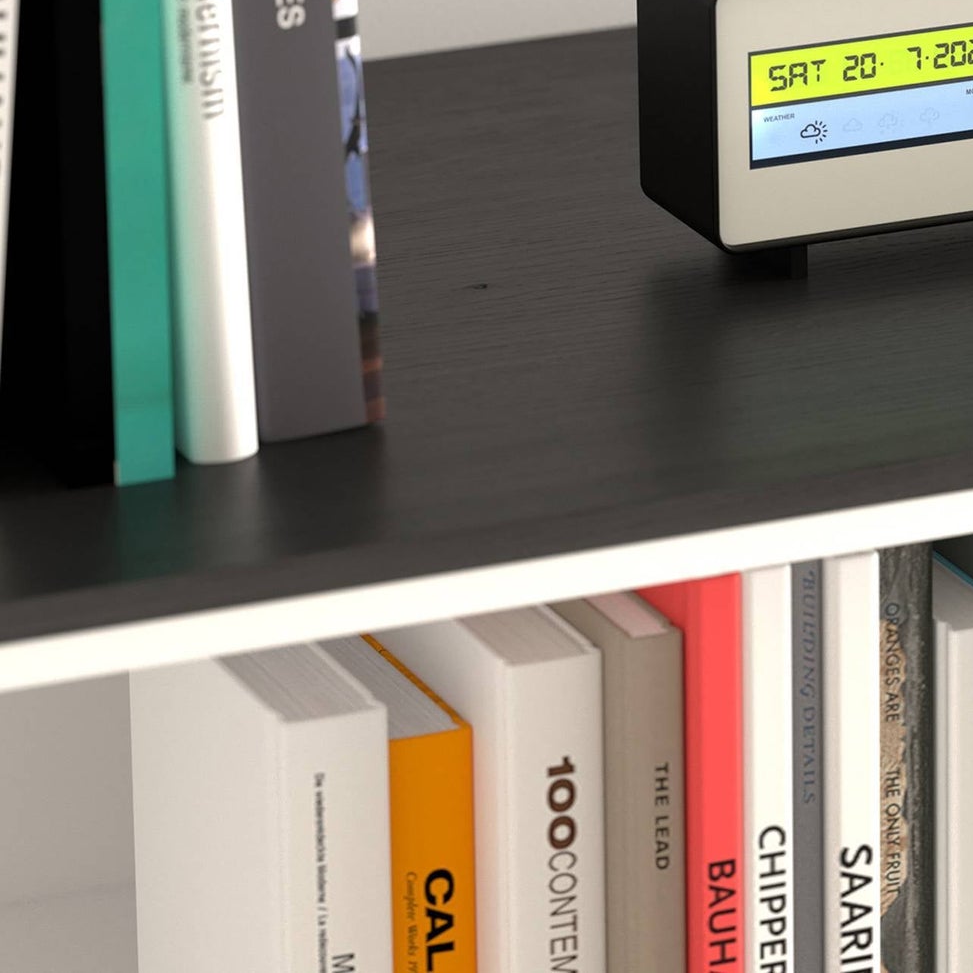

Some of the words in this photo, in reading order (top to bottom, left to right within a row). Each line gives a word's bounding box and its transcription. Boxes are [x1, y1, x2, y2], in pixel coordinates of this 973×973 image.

[768, 59, 826, 91] SAT
[763, 113, 795, 123] WEATHER
[798, 570, 817, 699] BUILDING
[884, 603, 901, 685] ORANGES
[884, 691, 900, 722] ARE
[801, 707, 815, 805] DETAILS
[654, 762, 668, 807] THE
[884, 769, 900, 799] THE
[655, 814, 669, 871] LEAD
[884, 803, 900, 846] ONLY
[884, 852, 900, 894] FRUIT
[708, 859, 736, 973] BAUH
[841, 845, 873, 973] SAARI
